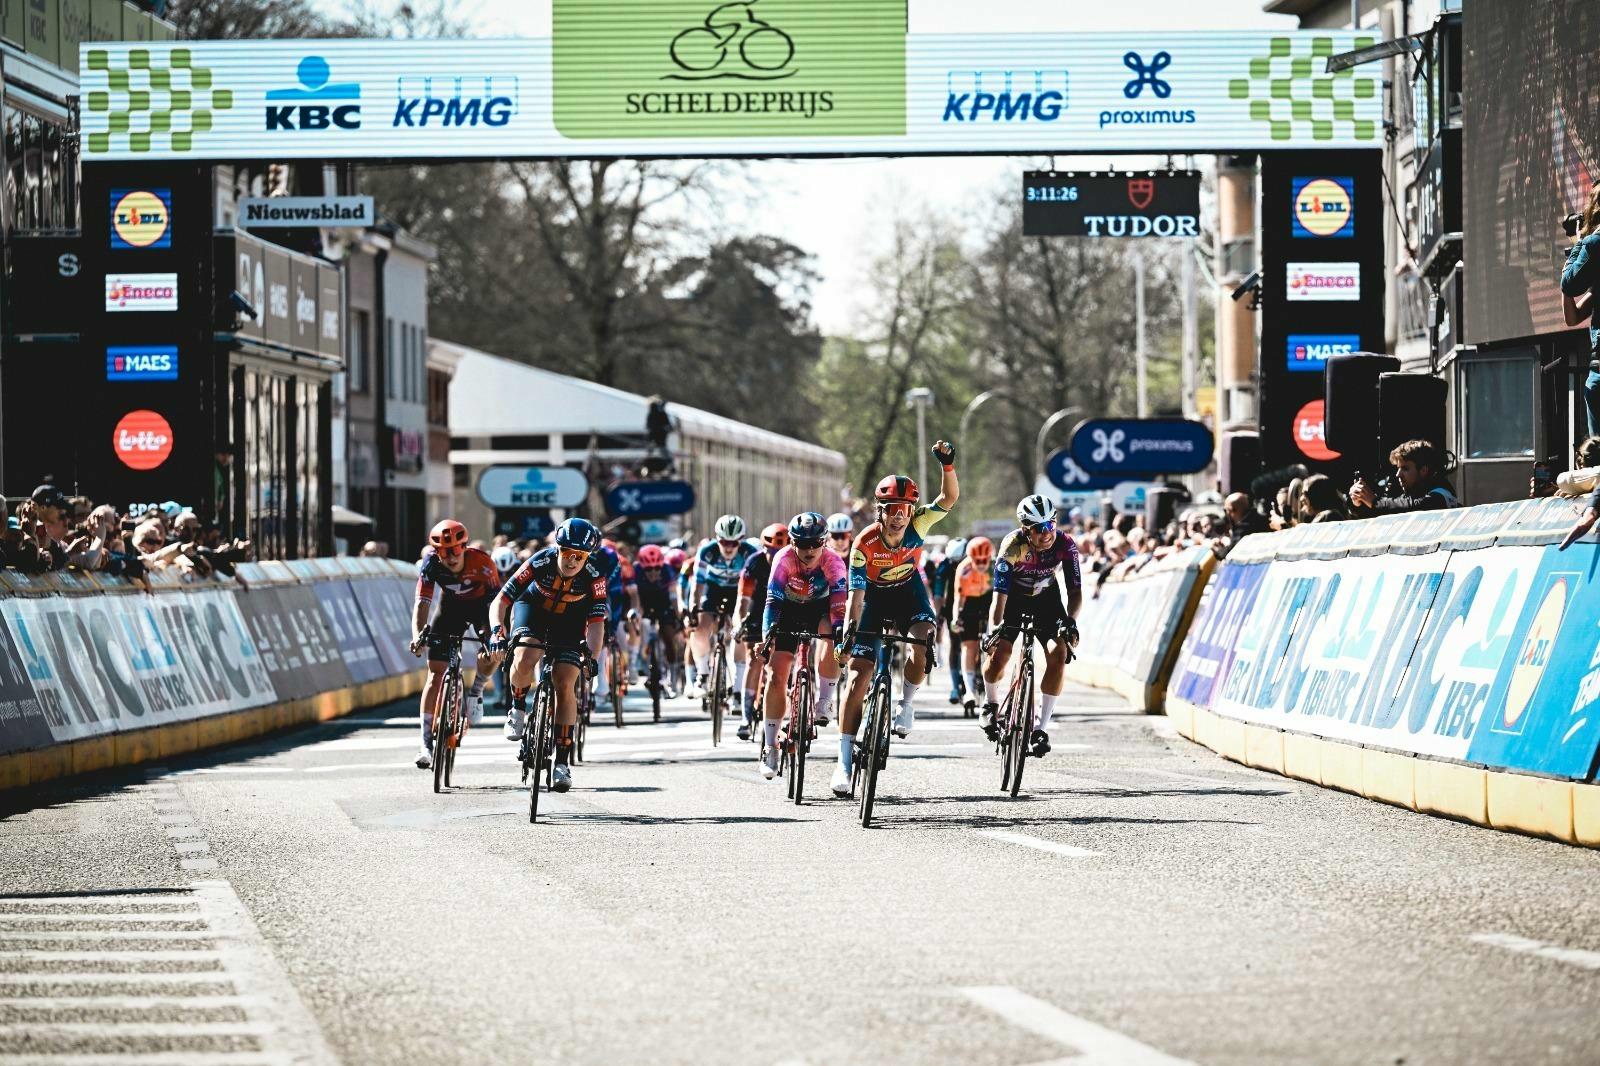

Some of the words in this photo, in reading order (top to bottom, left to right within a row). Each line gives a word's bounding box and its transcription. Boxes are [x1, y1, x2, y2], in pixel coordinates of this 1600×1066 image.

[266, 104, 361, 130] KBC
[393, 96, 514, 127] KPMG
[625, 91, 834, 119] SCHELDEPRIJS
[943, 91, 1064, 121] KPMG
[1100, 110, 1196, 129] proximus
[1027, 187, 1078, 201] 3:11:26
[247, 203, 366, 220] Nieuwsblad
[1084, 215, 1198, 237] TUDOR
[122, 284, 174, 300] Eneco
[1304, 273, 1355, 288] Eneco
[125, 354, 172, 372] MAES
[1130, 438, 1194, 454] proximus
[510, 491, 558, 505] KBC
[160, 602, 251, 704] KBC
[1241, 572, 1342, 714] KBC
[1349, 565, 1484, 735] KBC
[45, 608, 145, 724] KBC
[161, 673, 195, 709] KBC
[1433, 680, 1491, 740] KBC
